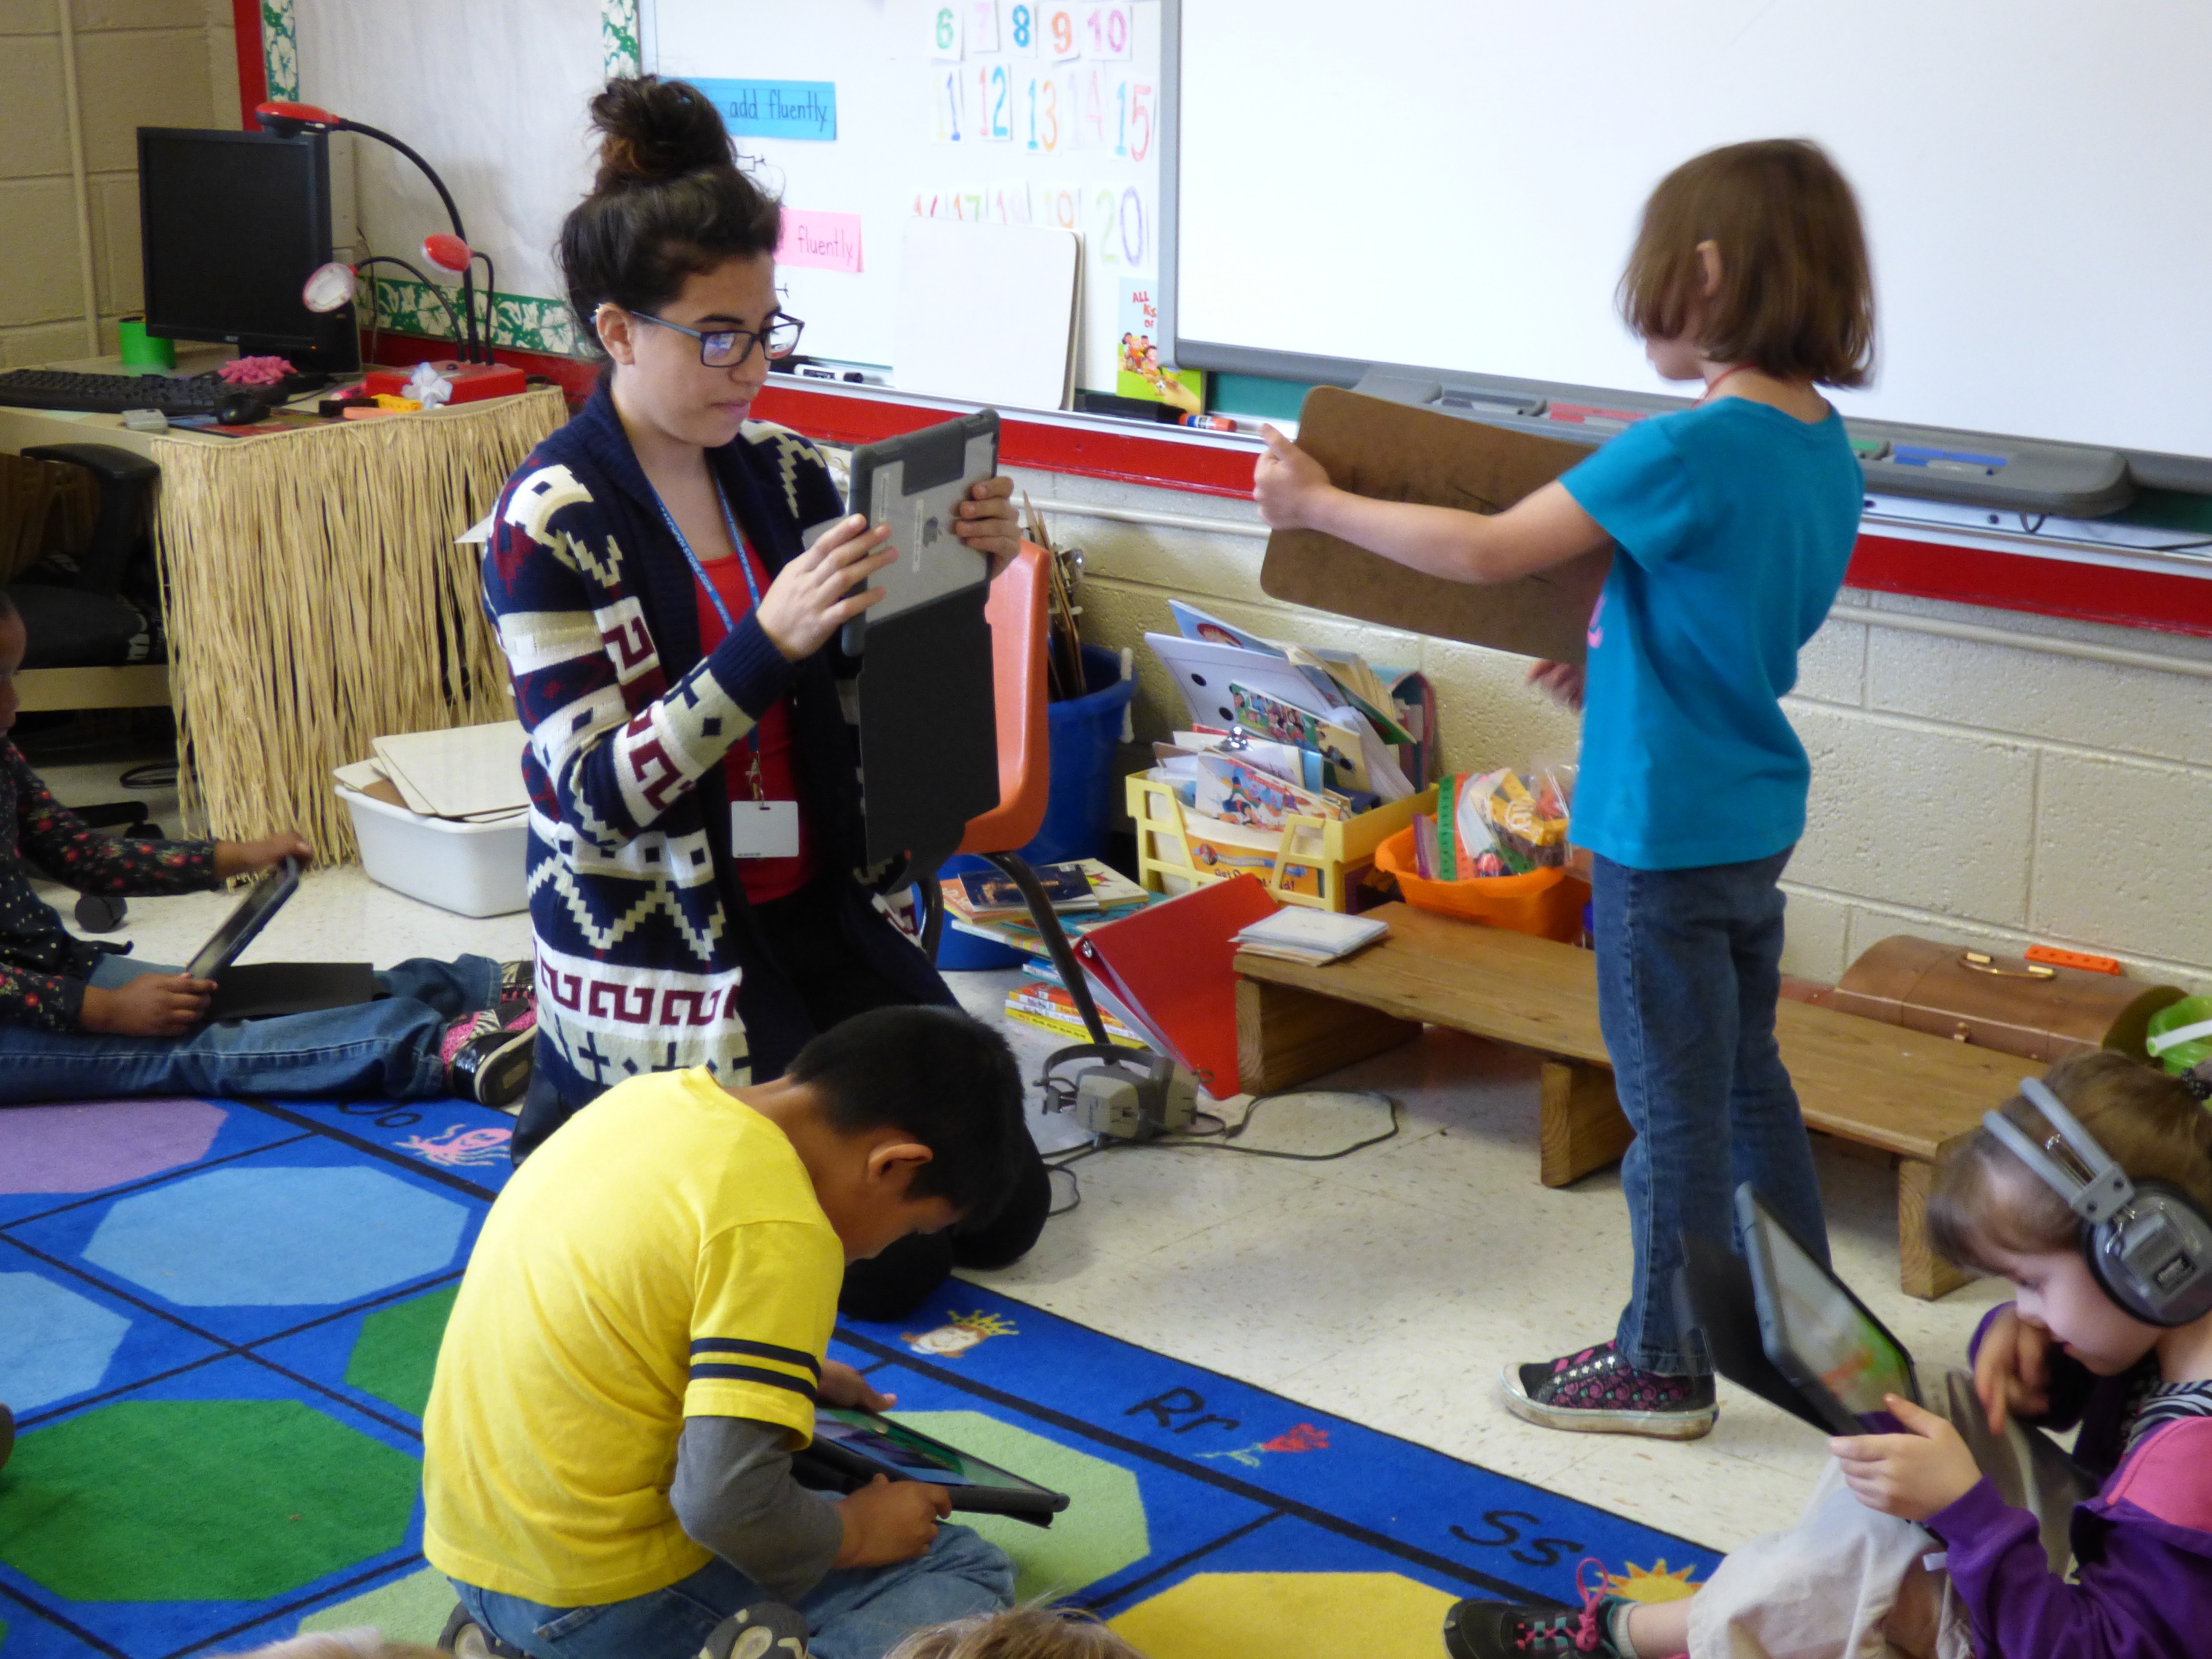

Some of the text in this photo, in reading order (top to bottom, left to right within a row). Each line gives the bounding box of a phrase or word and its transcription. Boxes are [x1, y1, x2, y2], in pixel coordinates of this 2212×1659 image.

[936, 2, 1127, 54] 6 7 8 9 10
[729, 88, 758, 120] add
[934, 65, 1152, 162] 11 12 13 14 15
[1096, 185, 1143, 267] 20
[1132, 290, 1149, 303] ALL
[1123, 1386, 1241, 1435] Rr
[1448, 1510, 1585, 1567] Ss
